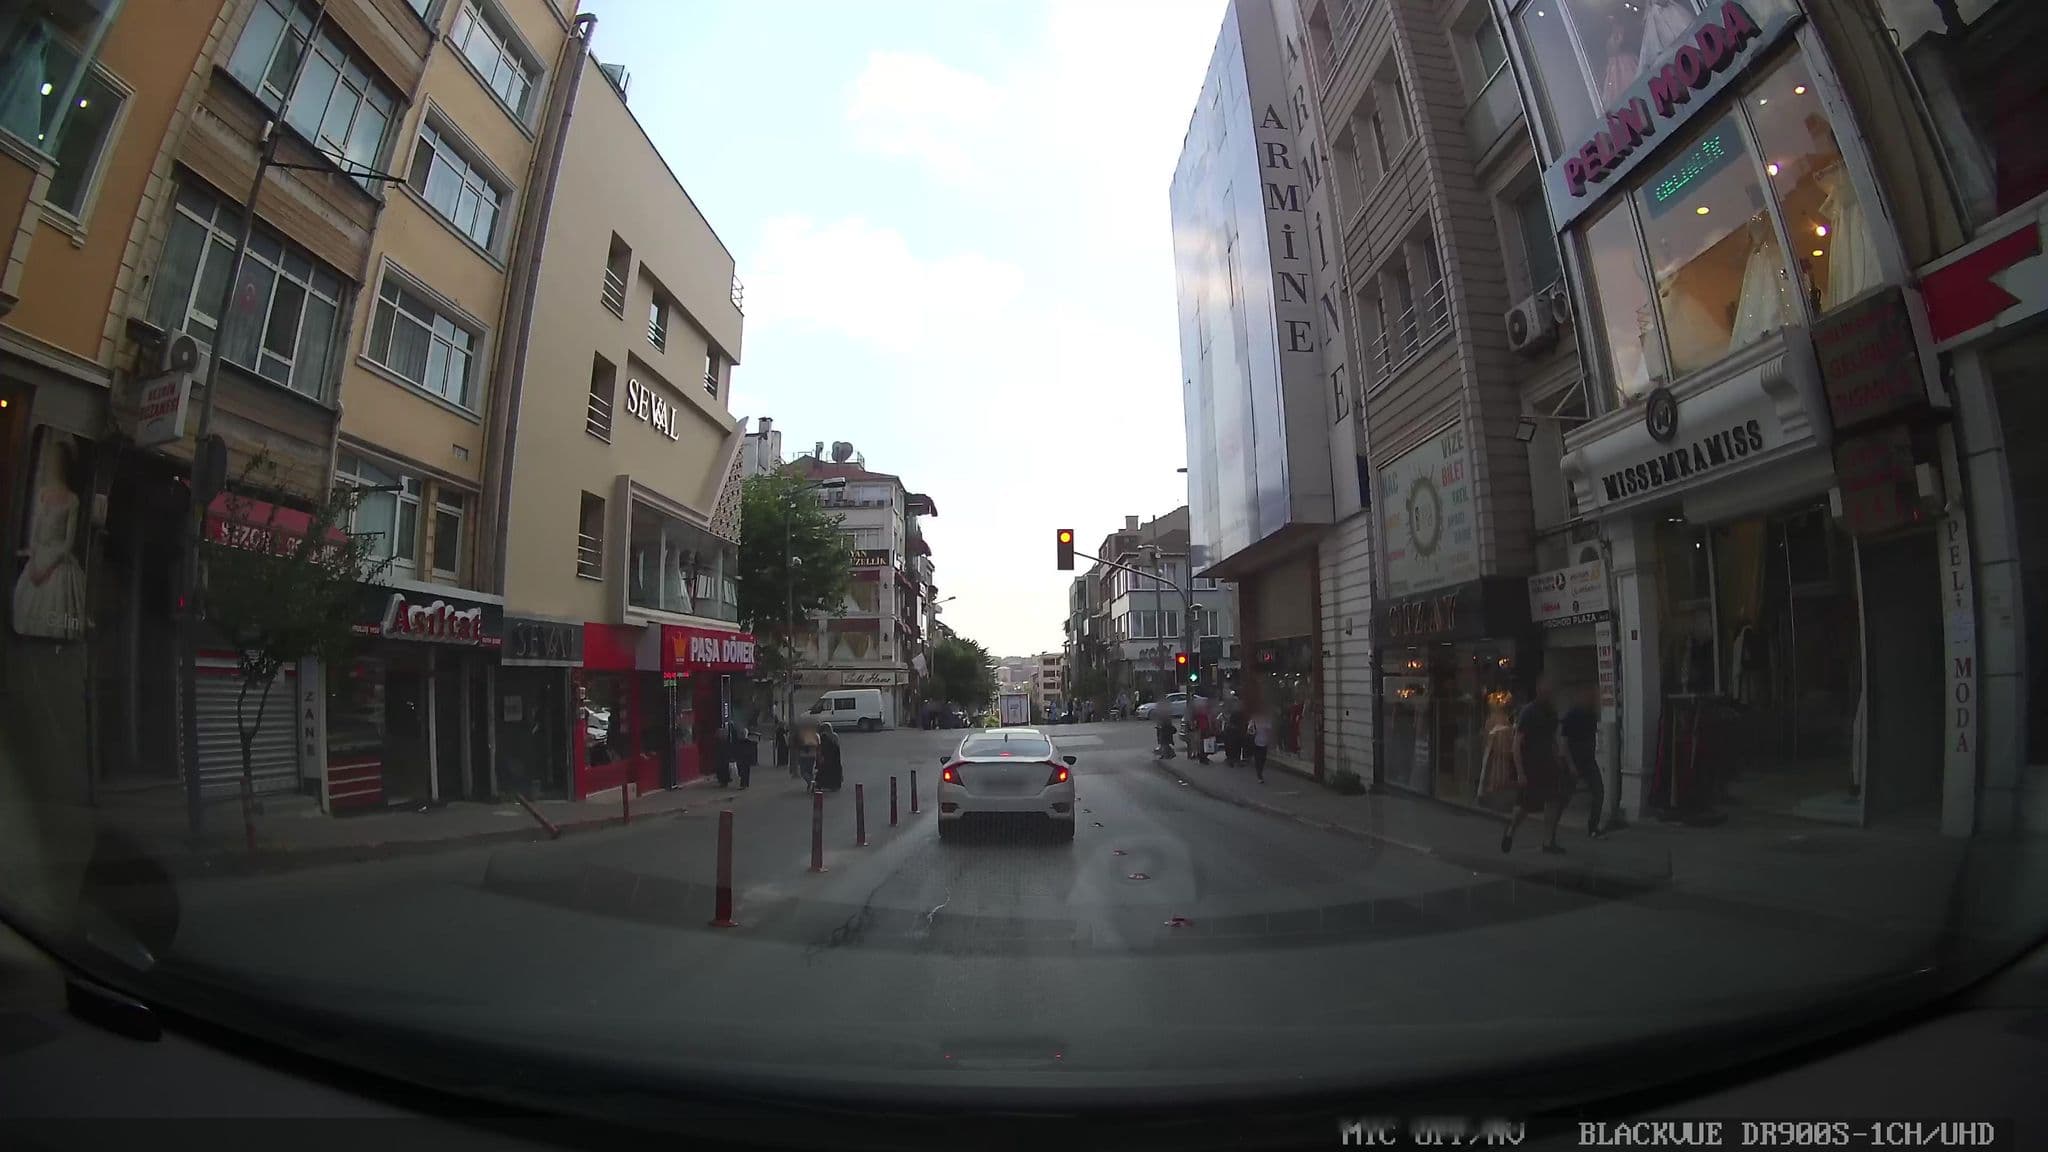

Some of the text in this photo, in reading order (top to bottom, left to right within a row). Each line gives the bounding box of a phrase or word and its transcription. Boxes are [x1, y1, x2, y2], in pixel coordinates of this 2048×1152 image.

[1563, 1, 1762, 197] PELİN MODA
[1571, 612, 1598, 624] PLAZA
[691, 635, 755, 668] PAŞA DÖNER
[1954, 656, 1973, 753] MODA
